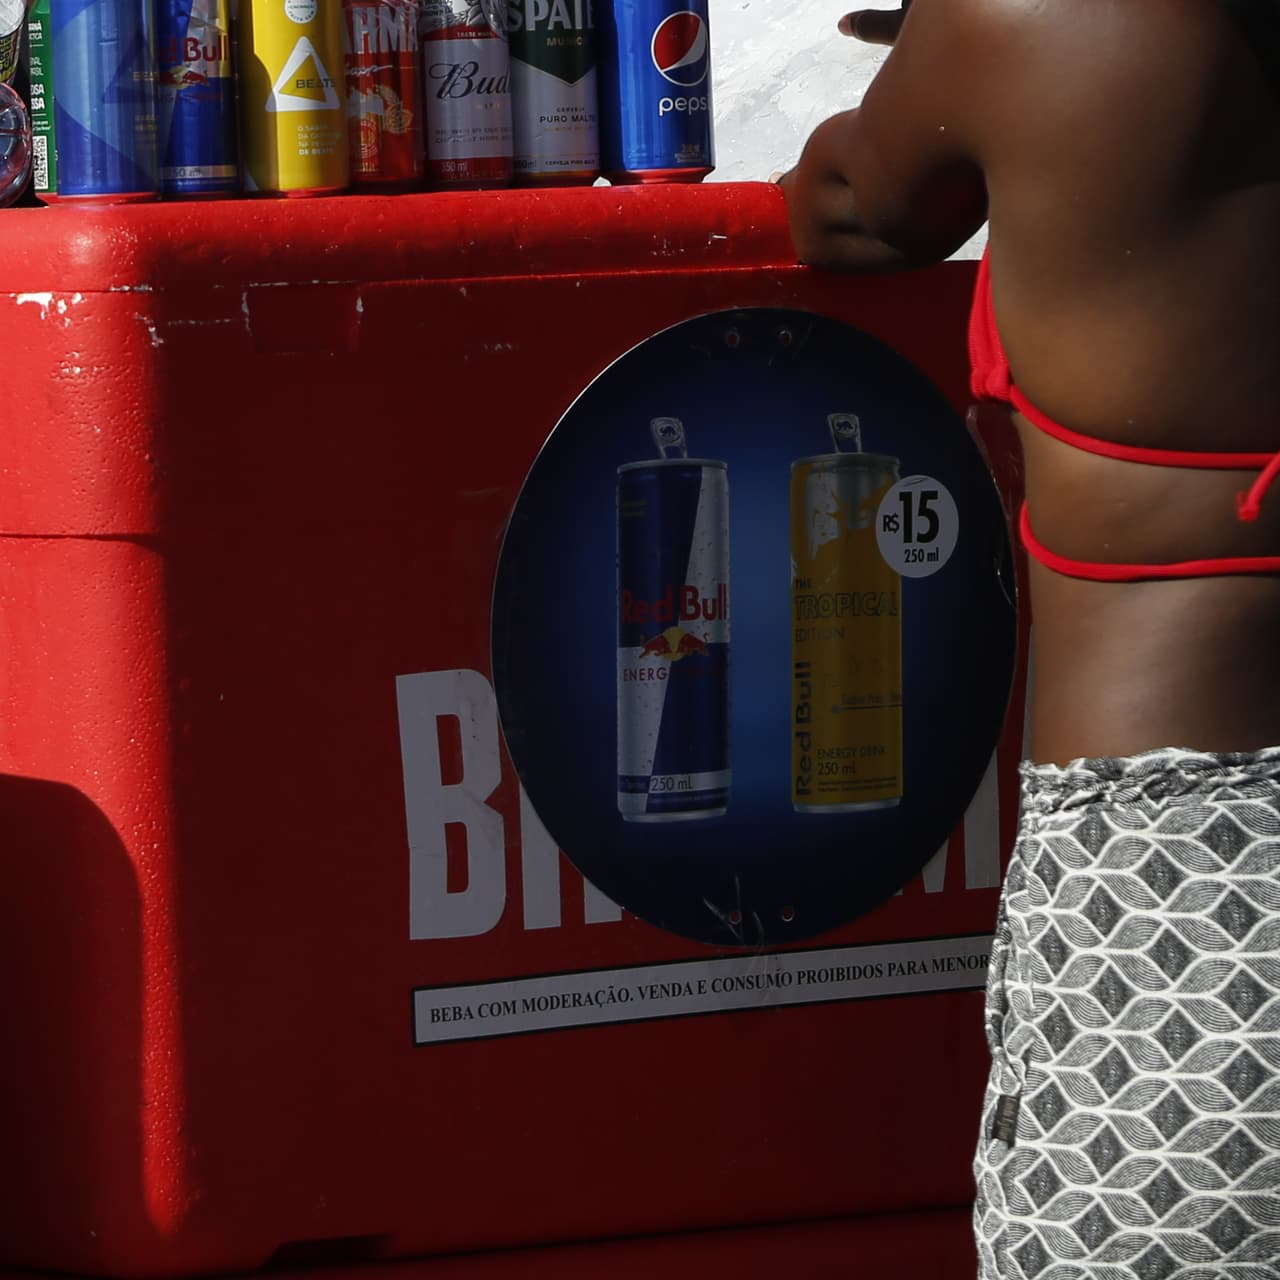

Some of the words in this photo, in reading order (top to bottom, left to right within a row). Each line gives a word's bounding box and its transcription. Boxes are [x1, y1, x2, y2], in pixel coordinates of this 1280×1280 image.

[184, 34, 228, 61] Bull
[539, 114, 568, 123] PURO
[883, 513, 899, 533] R$
[899, 490, 940, 544] 15
[904, 548, 924, 563] 250
[927, 546, 939, 562] ml
[622, 583, 673, 622] Red
[679, 583, 727, 620] Bull
[794, 591, 898, 619] TROPICAL
[795, 660, 812, 724] Bull
[795, 731, 812, 797] Red
[651, 776, 674, 791] 250
[430, 1006, 474, 1025] BEBA
[478, 1001, 517, 1019] COM
[521, 984, 634, 1014] MODERAÇÃO.
[638, 981, 693, 1001] VENDA
[697, 978, 707, 995] E
[711, 969, 793, 994] CONSUMO
[797, 962, 883, 986] PROIBIDOS
[887, 957, 928, 977] PARA
